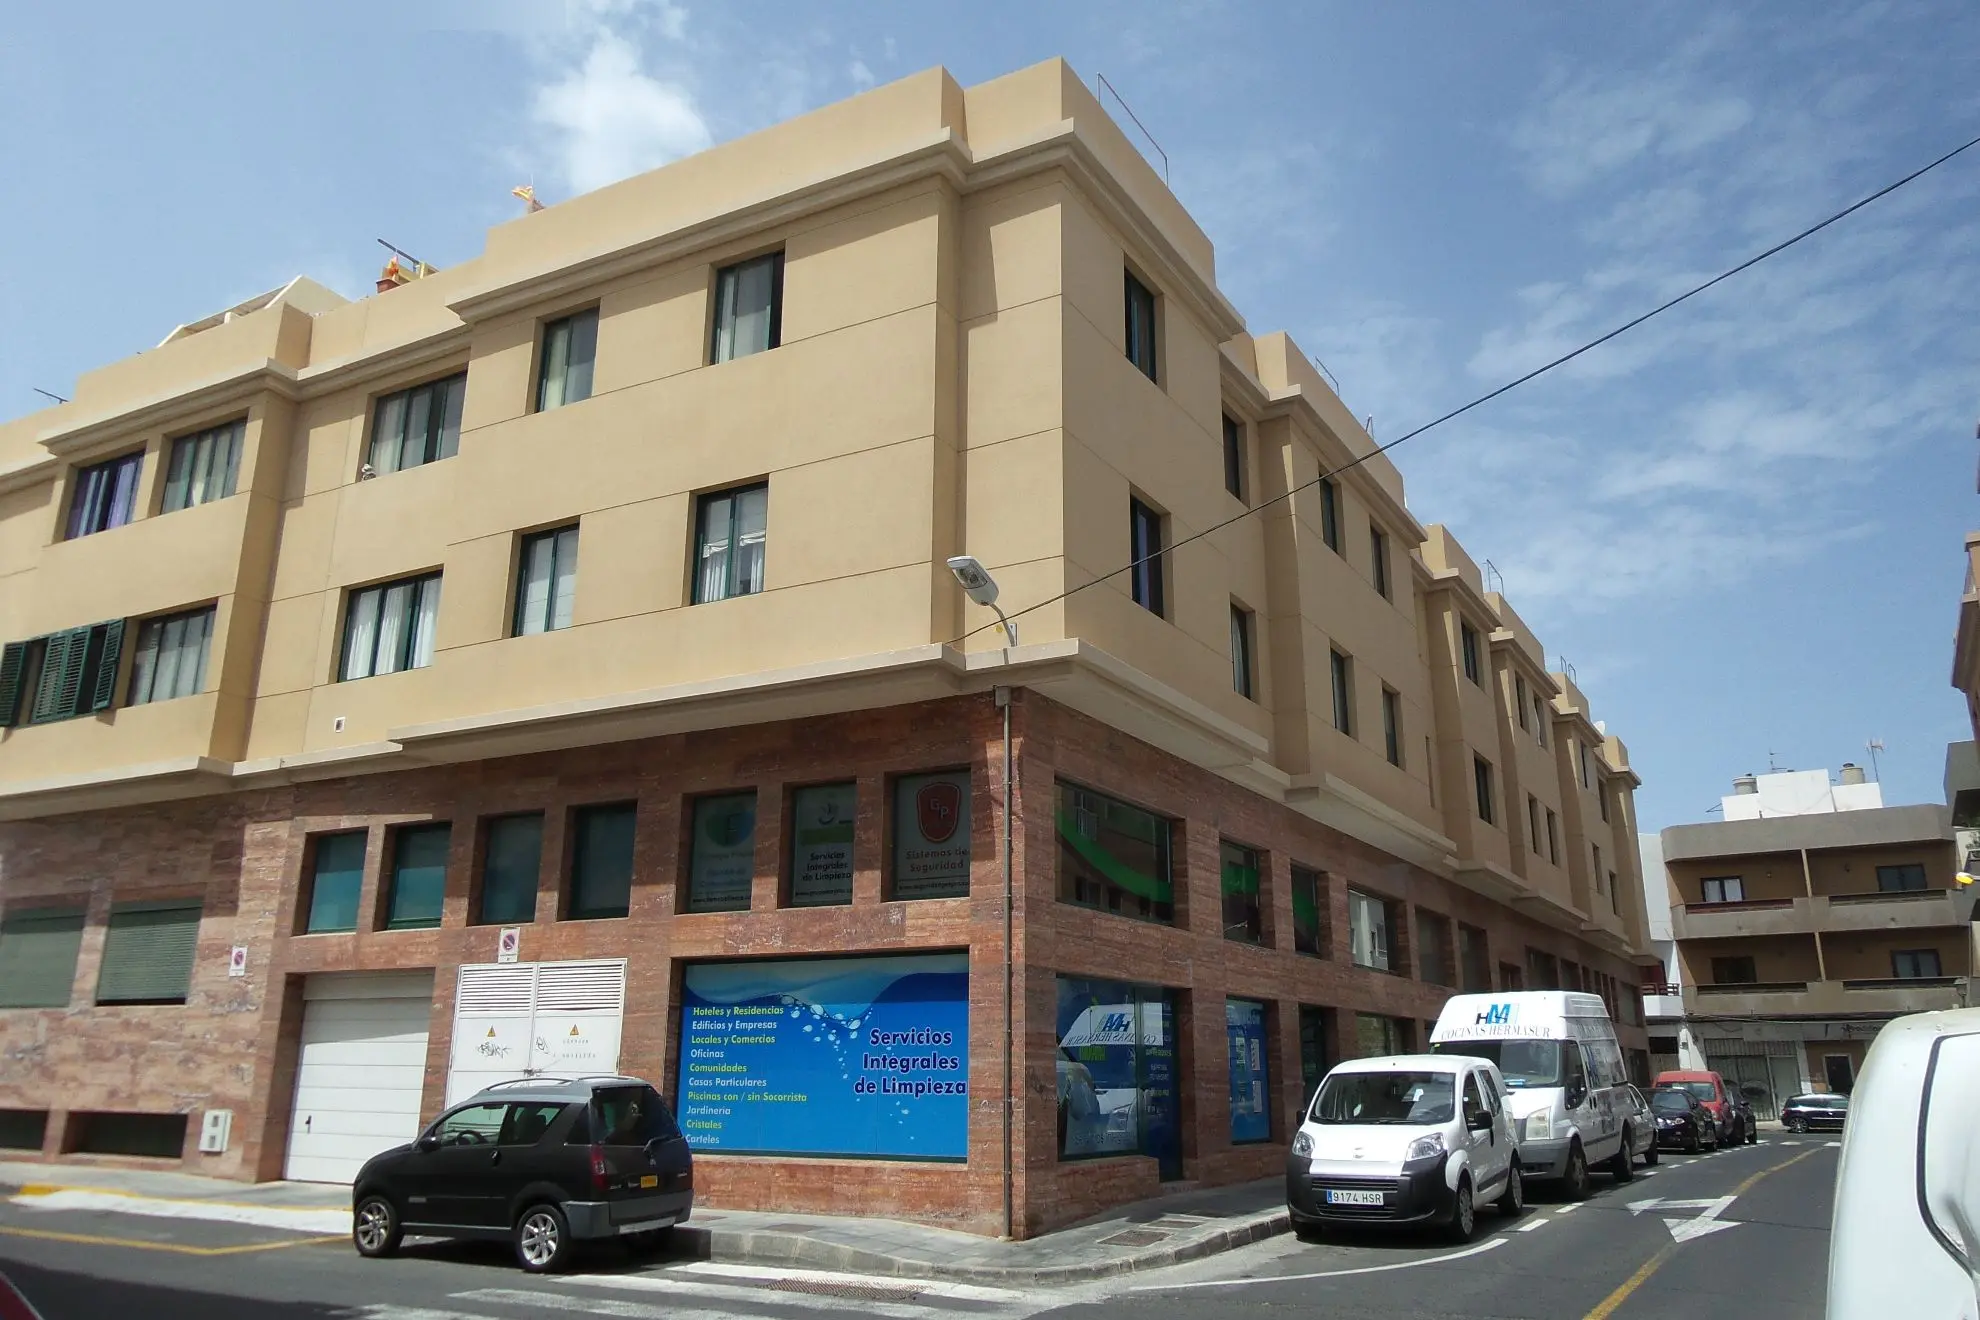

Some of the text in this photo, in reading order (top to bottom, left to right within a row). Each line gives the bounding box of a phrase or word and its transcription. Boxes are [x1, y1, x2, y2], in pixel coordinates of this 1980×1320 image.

[810, 851, 845, 861] Servicios
[905, 846, 968, 860] Sistemas de
[807, 861, 848, 872] Integrales
[910, 860, 964, 873] Seguridad
[815, 872, 852, 883] Limpieza
[693, 1006, 784, 1017] Hoteles y Residencias
[692, 1020, 777, 1031] Edificios y Empresas
[869, 1027, 953, 1047] Servicios
[1441, 1023, 1550, 1040] COCINAS HERMASUR
[691, 1034, 775, 1045] Locales y Comercios
[690, 1049, 724, 1058] Oficinas
[689, 1062, 747, 1072] Comunidades
[863, 1051, 960, 1074] Integrales
[688, 1077, 767, 1087] Casas Particulares
[854, 1075, 967, 1099] de Limpieza
[688, 1091, 721, 1101] Piscinas
[723, 1093, 738, 1101] con
[747, 1091, 760, 1101] sin
[763, 1091, 807, 1102] Socorrista
[686, 1119, 722, 1129] Cristales
[685, 1134, 720, 1144] Carteles
[1333, 1192, 1382, 1204] 9174 HSR
